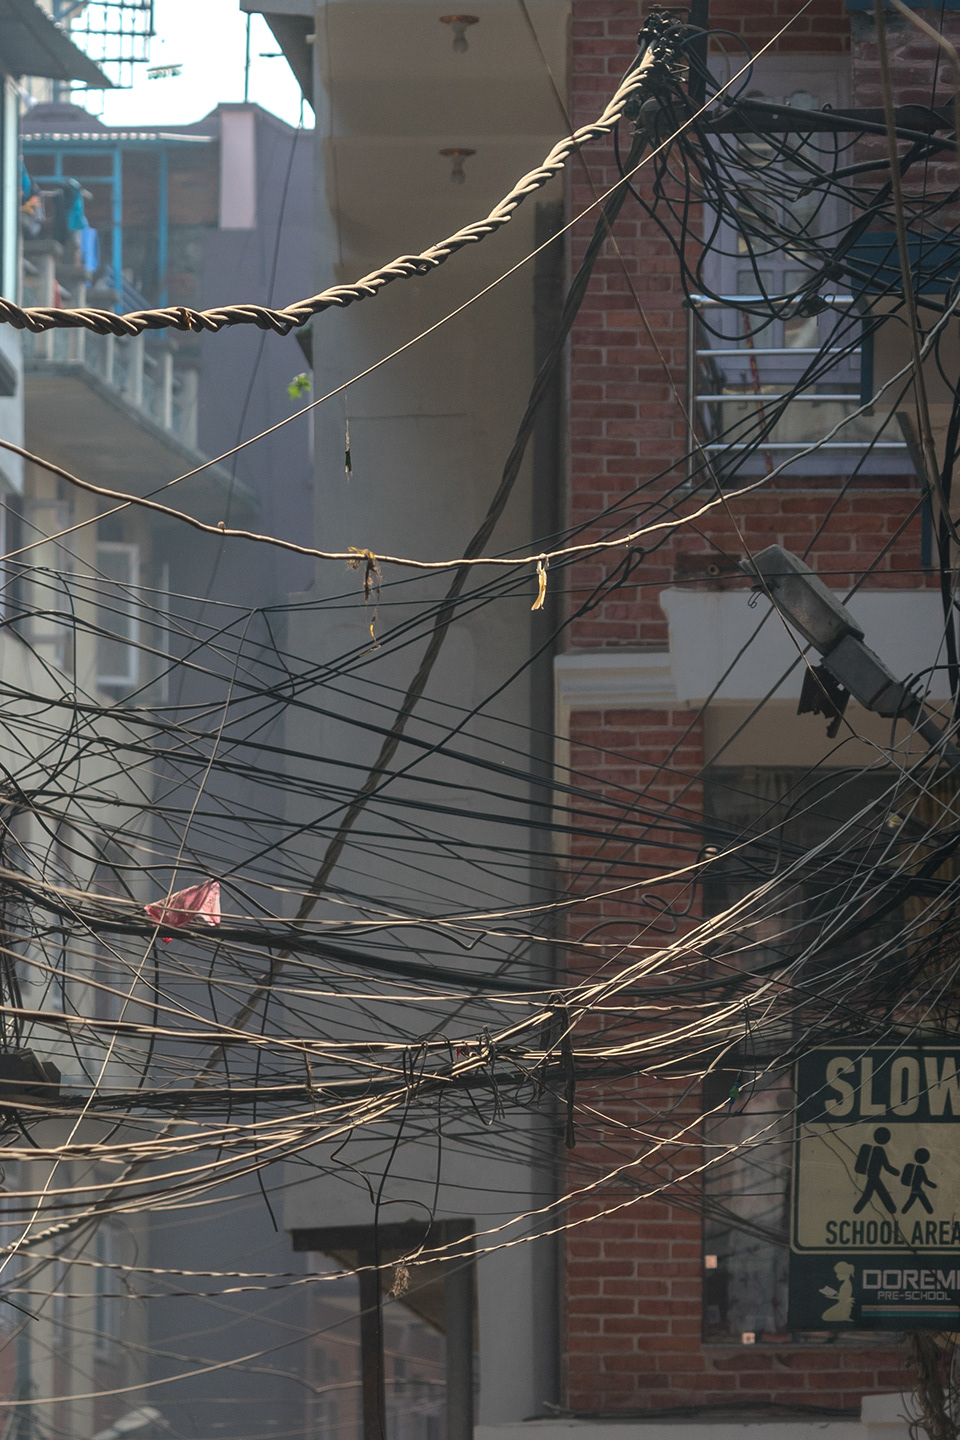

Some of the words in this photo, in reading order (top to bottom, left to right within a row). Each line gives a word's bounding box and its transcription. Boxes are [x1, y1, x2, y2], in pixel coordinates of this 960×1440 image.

[825, 1056, 960, 1117] SLOW
[825, 1220, 905, 1245] SCHOOL
[911, 1220, 960, 1245] AREA
[877, 1290, 952, 1300] PRE-SCHOOL
